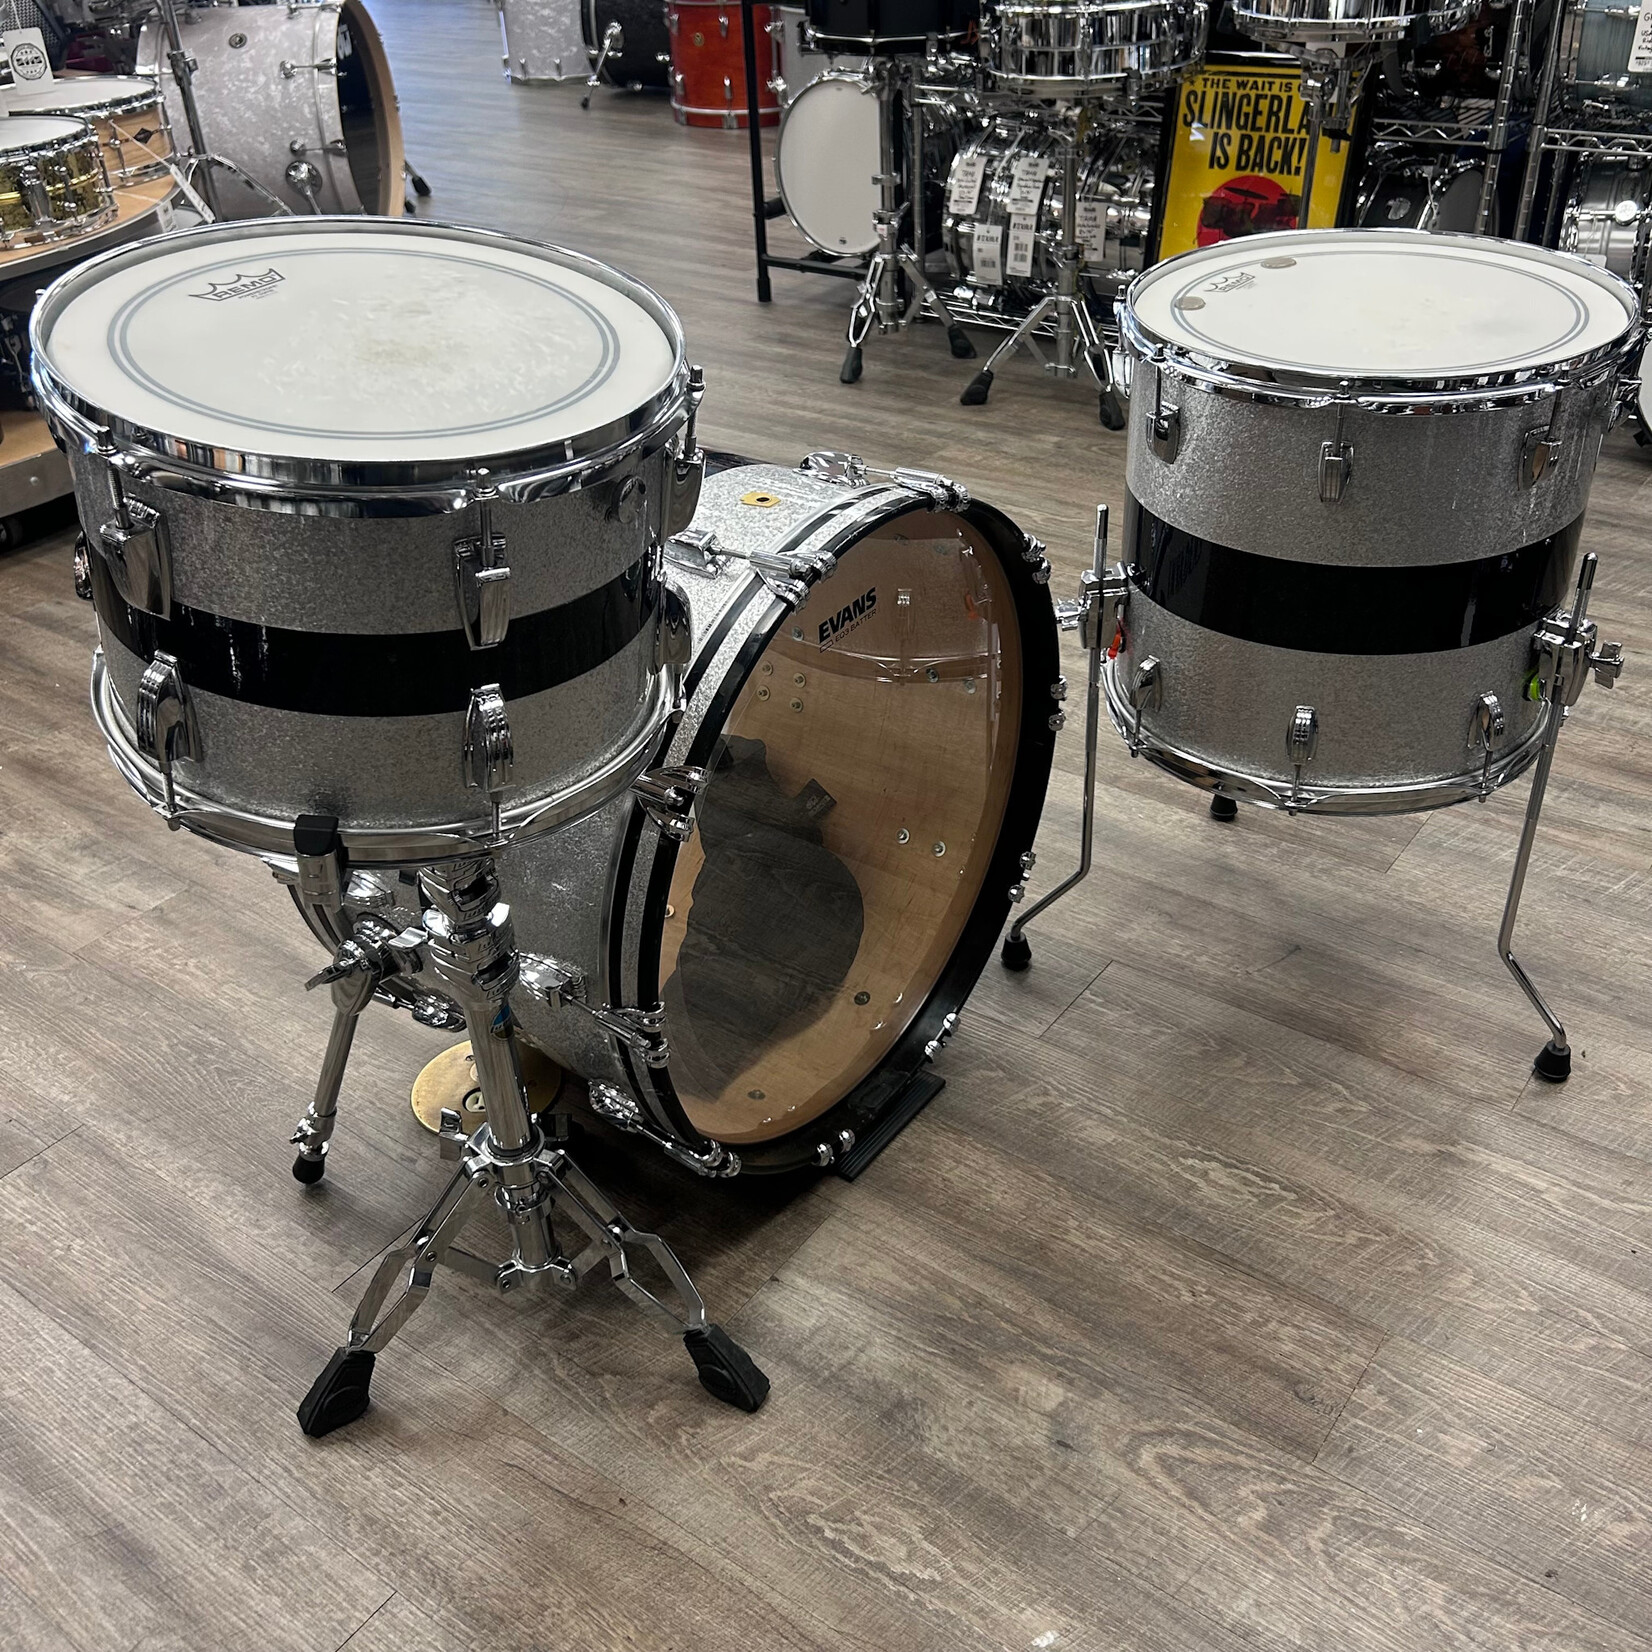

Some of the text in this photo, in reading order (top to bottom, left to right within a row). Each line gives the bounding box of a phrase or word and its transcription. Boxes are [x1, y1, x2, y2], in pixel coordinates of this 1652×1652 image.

[1202, 77, 1231, 90] THE
[1236, 79, 1276, 93] WAIT
[1279, 81, 1293, 93] IS
[1183, 89, 1311, 135] SLINGERLA
[1208, 132, 1307, 177] IS BACK!
[211, 274, 278, 298] REMO
[818, 586, 877, 643] EVANS
[850, 608, 877, 632] BATTER
